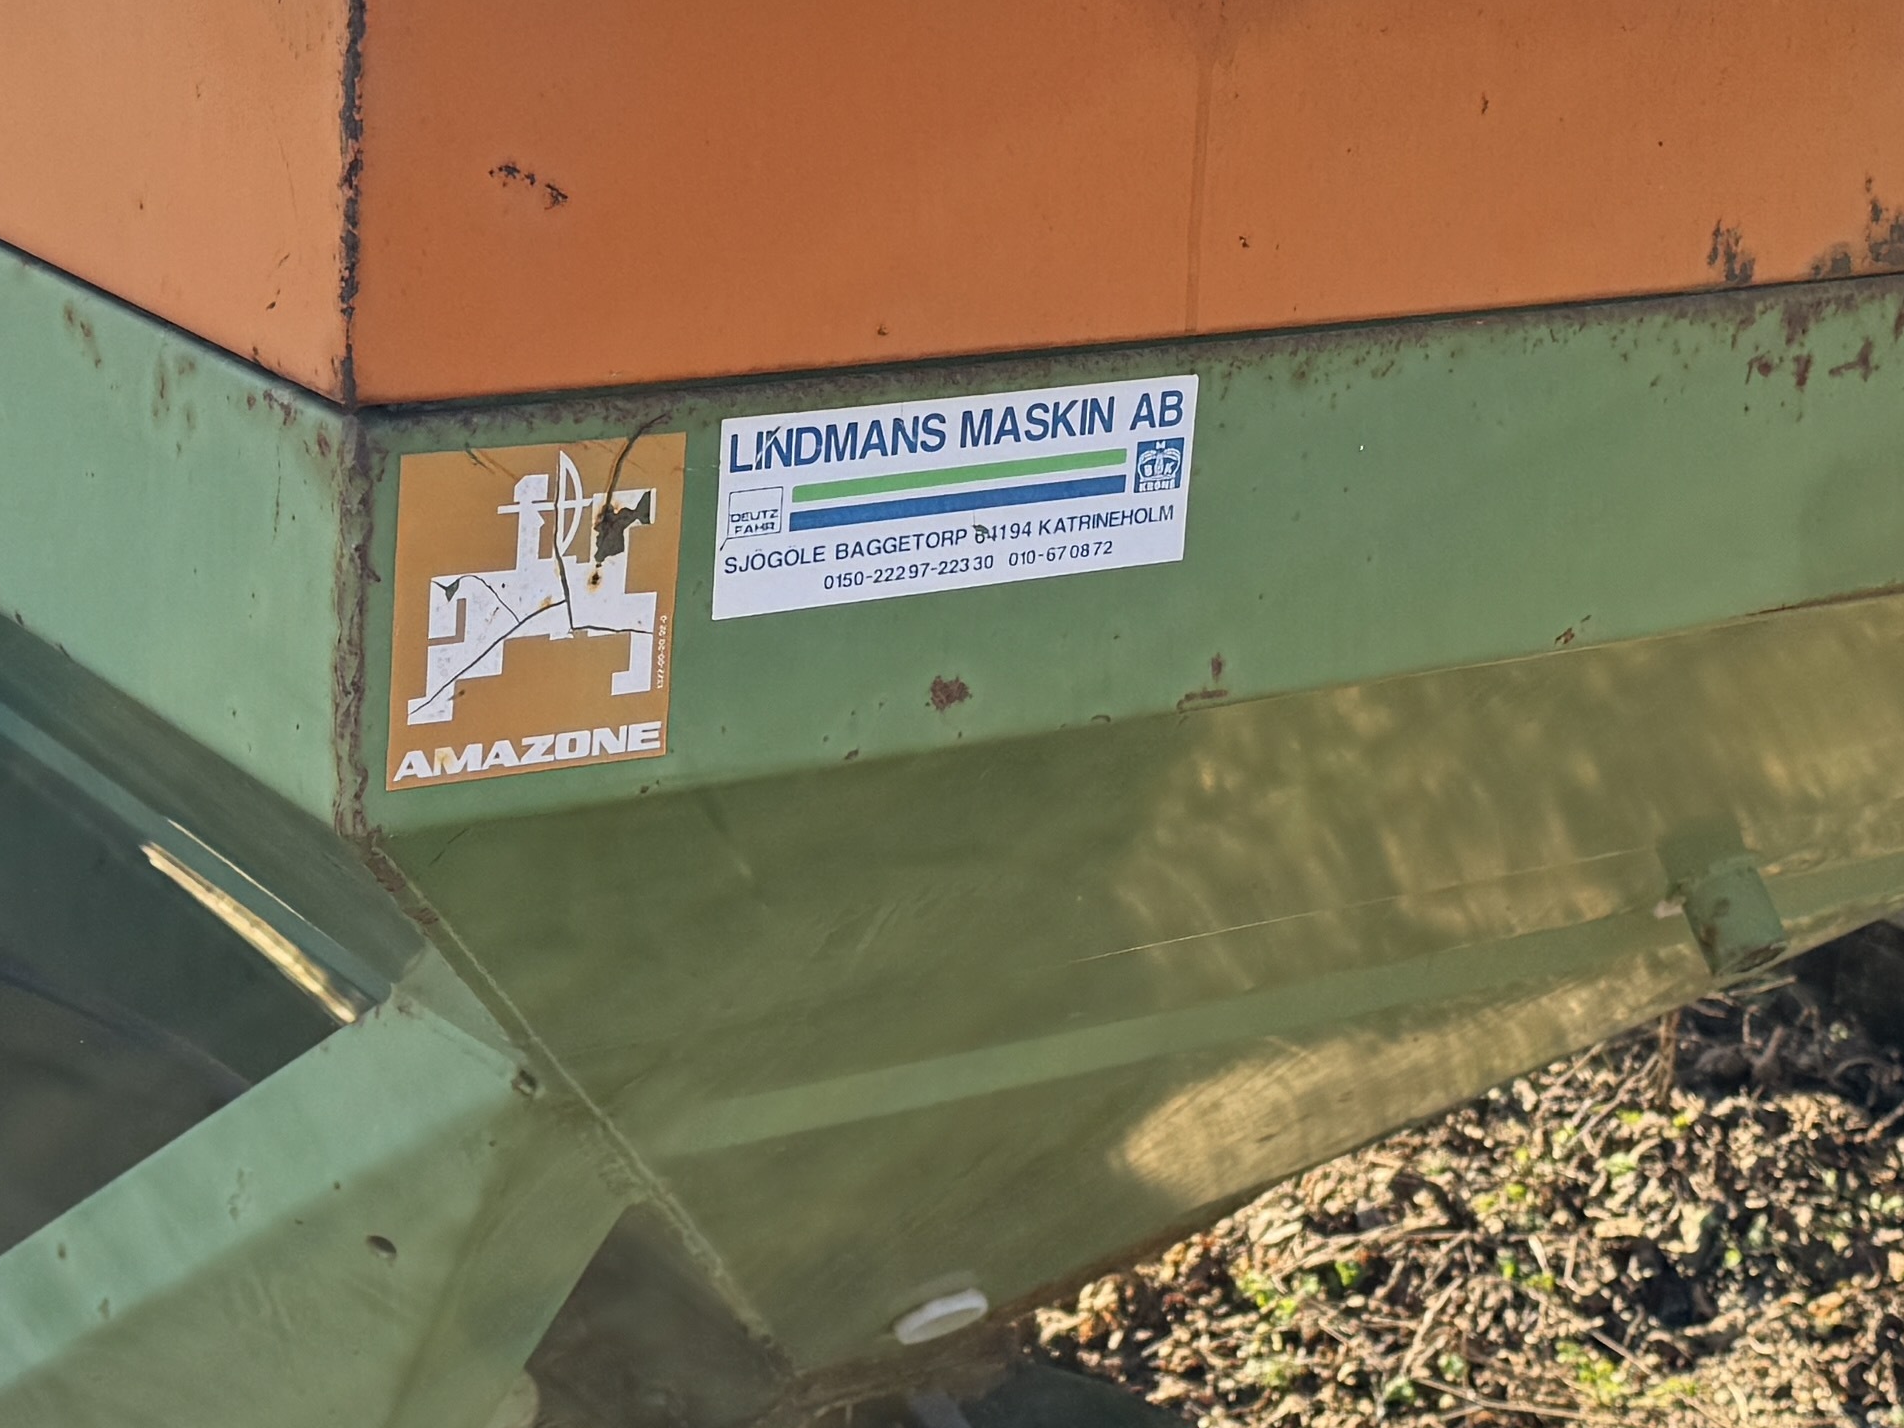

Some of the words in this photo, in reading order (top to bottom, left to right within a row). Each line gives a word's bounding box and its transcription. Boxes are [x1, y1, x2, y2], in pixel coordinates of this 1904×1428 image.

[729, 413, 946, 474] LINDMANS
[960, 396, 1116, 449] MASKIN
[1130, 389, 1184, 431] AB
[1139, 478, 1176, 492] KRONE
[730, 508, 779, 523] DEUTZ
[734, 521, 775, 535] FAHR
[724, 545, 825, 575] SJÖGÖLE
[835, 528, 968, 561] BAGGETORP
[1039, 505, 1174, 536] KATRINEHOLM
[393, 721, 662, 782] AMAZONE
